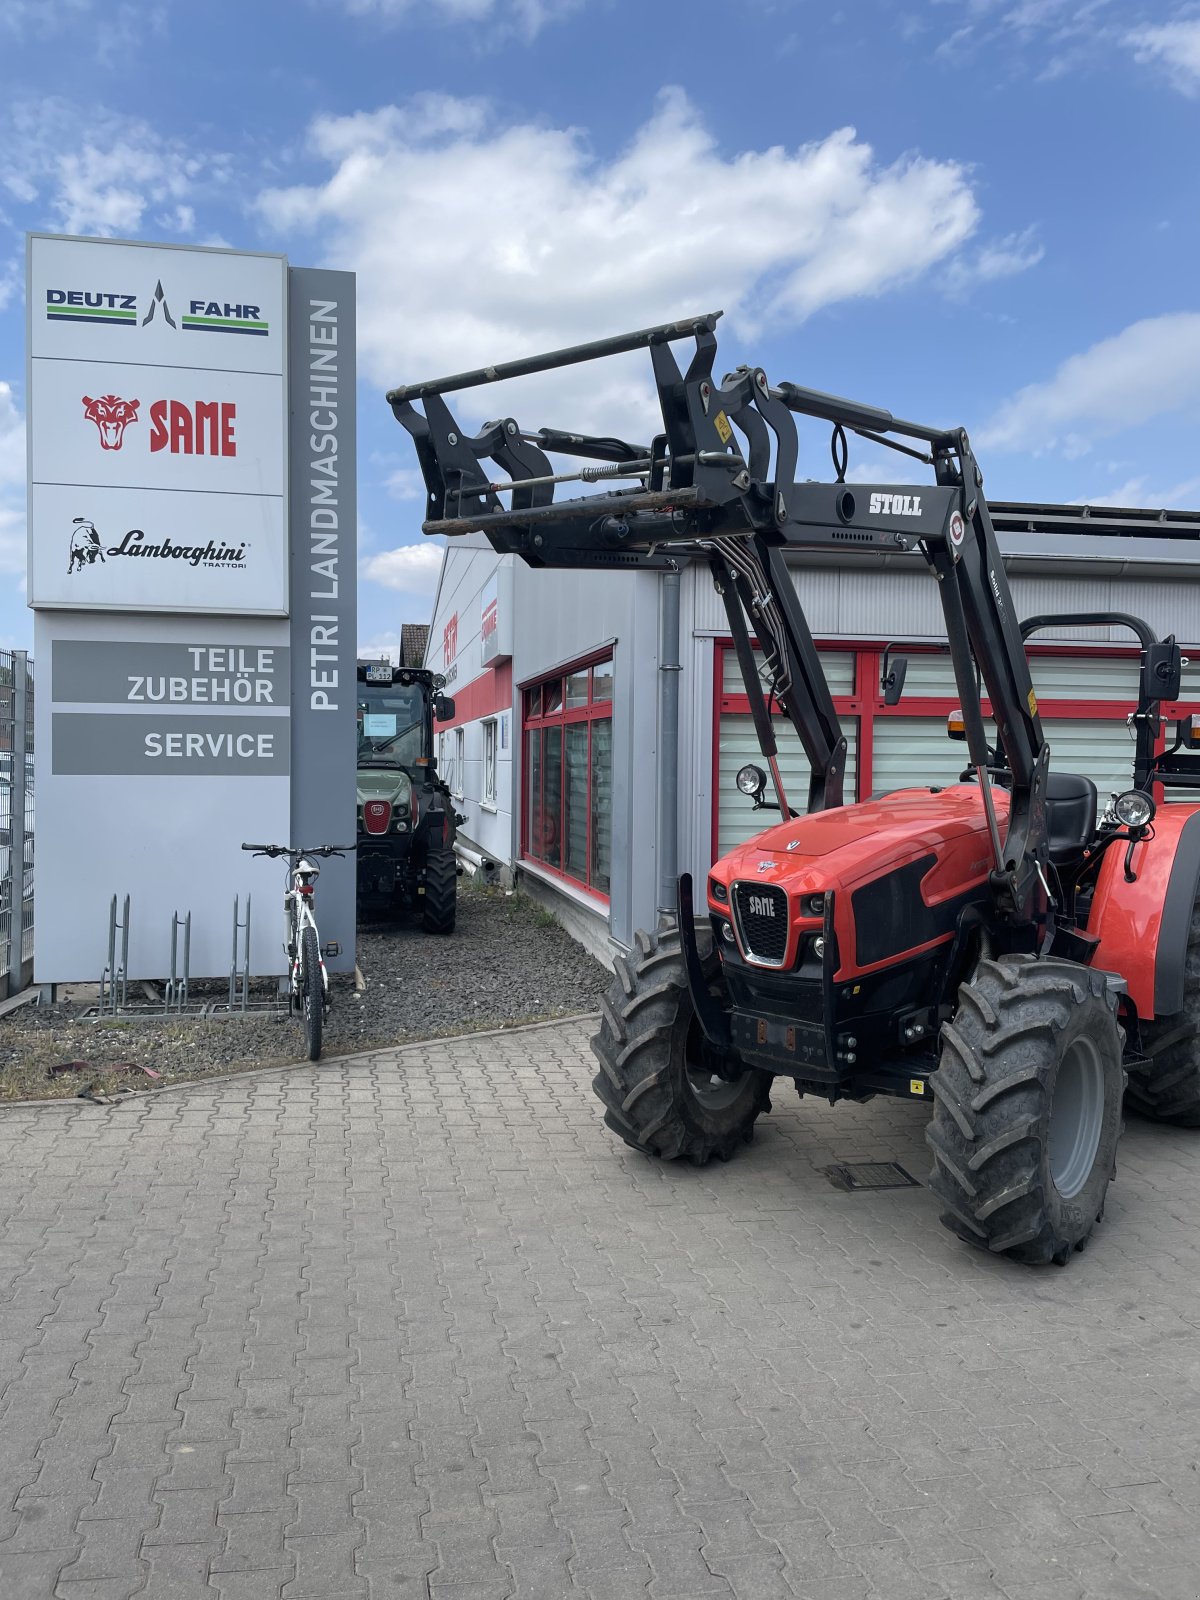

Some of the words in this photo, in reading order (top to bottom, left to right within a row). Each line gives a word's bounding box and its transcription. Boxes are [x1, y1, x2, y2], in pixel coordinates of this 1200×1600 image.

[47, 289, 137, 309] DEUTZ
[190, 300, 260, 320] FAHR
[150, 399, 236, 457] SAME
[309, 299, 339, 599] LANDMASCHINEN
[869, 493, 922, 516] STOLL
[106, 529, 246, 566] Lamborghini
[188, 648, 274, 673] TEILE
[310, 614, 339, 711] PETRI
[128, 673, 274, 703] ZUBEHÖR
[144, 733, 274, 758] SERVICE
[749, 896, 775, 917] SAME
